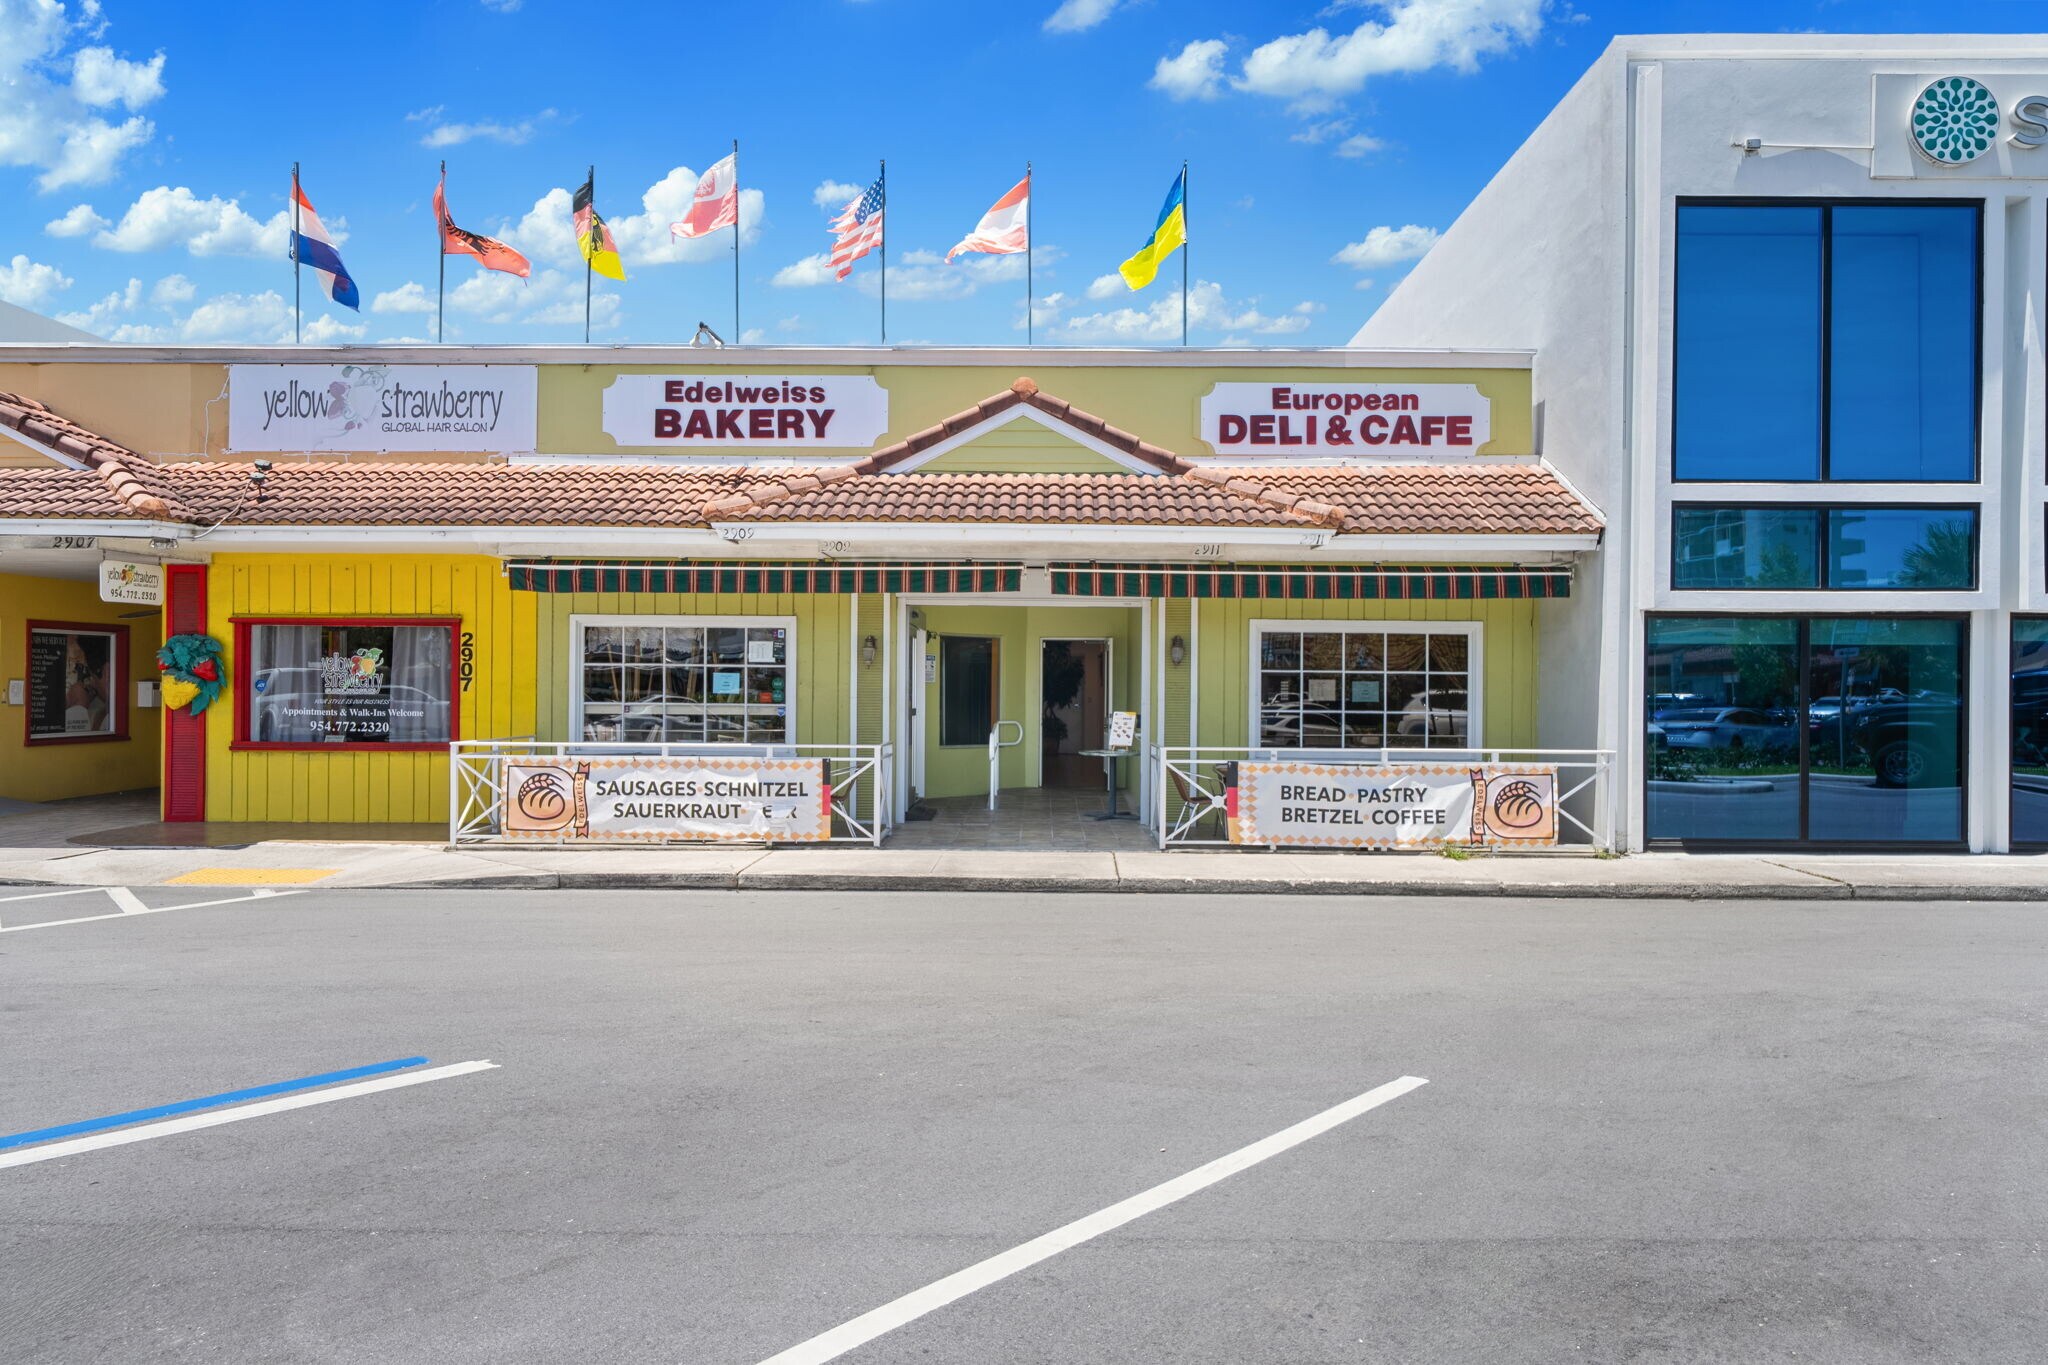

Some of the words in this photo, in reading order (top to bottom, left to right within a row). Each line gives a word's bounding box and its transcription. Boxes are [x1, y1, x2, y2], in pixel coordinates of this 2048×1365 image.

[665, 380, 826, 404] Edelweiss
[264, 379, 330, 431] yellow
[381, 379, 503, 431] strawberry
[1271, 387, 1419, 415] European
[381, 422, 425, 433] GLOBAL
[427, 422, 452, 433] HAIR
[453, 422, 488, 433] SALON
[654, 409, 836, 439] BAKERY
[53, 536, 96, 549] 2907
[722, 528, 755, 540] 2909
[110, 588, 157, 601] 954.772.2320
[460, 632, 474, 692] 2907
[281, 706, 338, 718] Appointments
[340, 708, 347, 717] &
[349, 708, 387, 717] Walk-Ins
[388, 708, 424, 717] Welcome
[310, 720, 390, 733] 954.772.2320
[595, 781, 697, 797] SAUSAGES
[703, 781, 809, 798] SCHNITZEL
[1280, 785, 1346, 802] BREAD
[1357, 787, 1428, 803] PASTRY
[613, 803, 742, 819] SAUERKRAUT
[1281, 807, 1364, 825] BRETZEL
[1371, 809, 1446, 825] COFFEE
